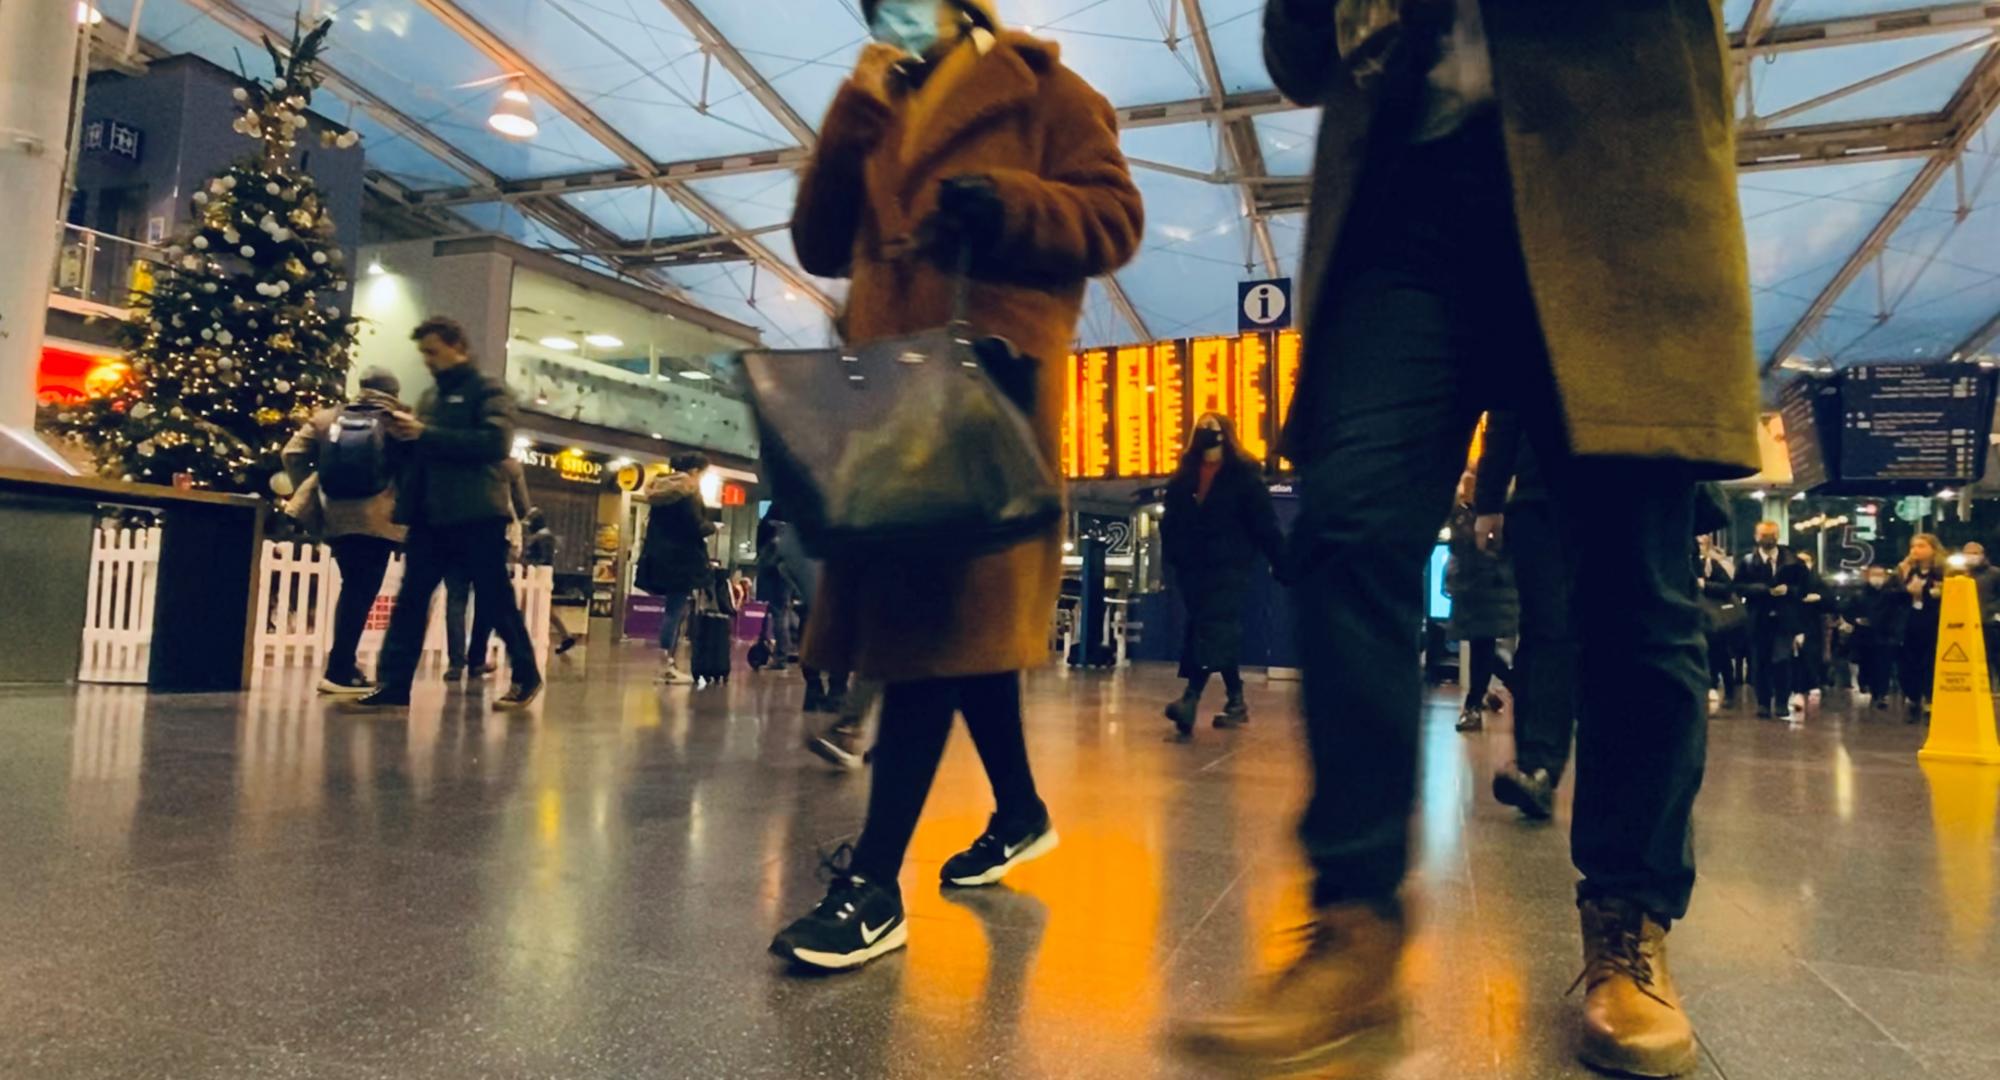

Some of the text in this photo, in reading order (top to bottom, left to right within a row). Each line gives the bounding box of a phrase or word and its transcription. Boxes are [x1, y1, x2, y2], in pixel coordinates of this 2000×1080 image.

[561, 456, 603, 476] SHOP
[1105, 521, 1132, 557] 2
[1840, 525, 1875, 570] 5
